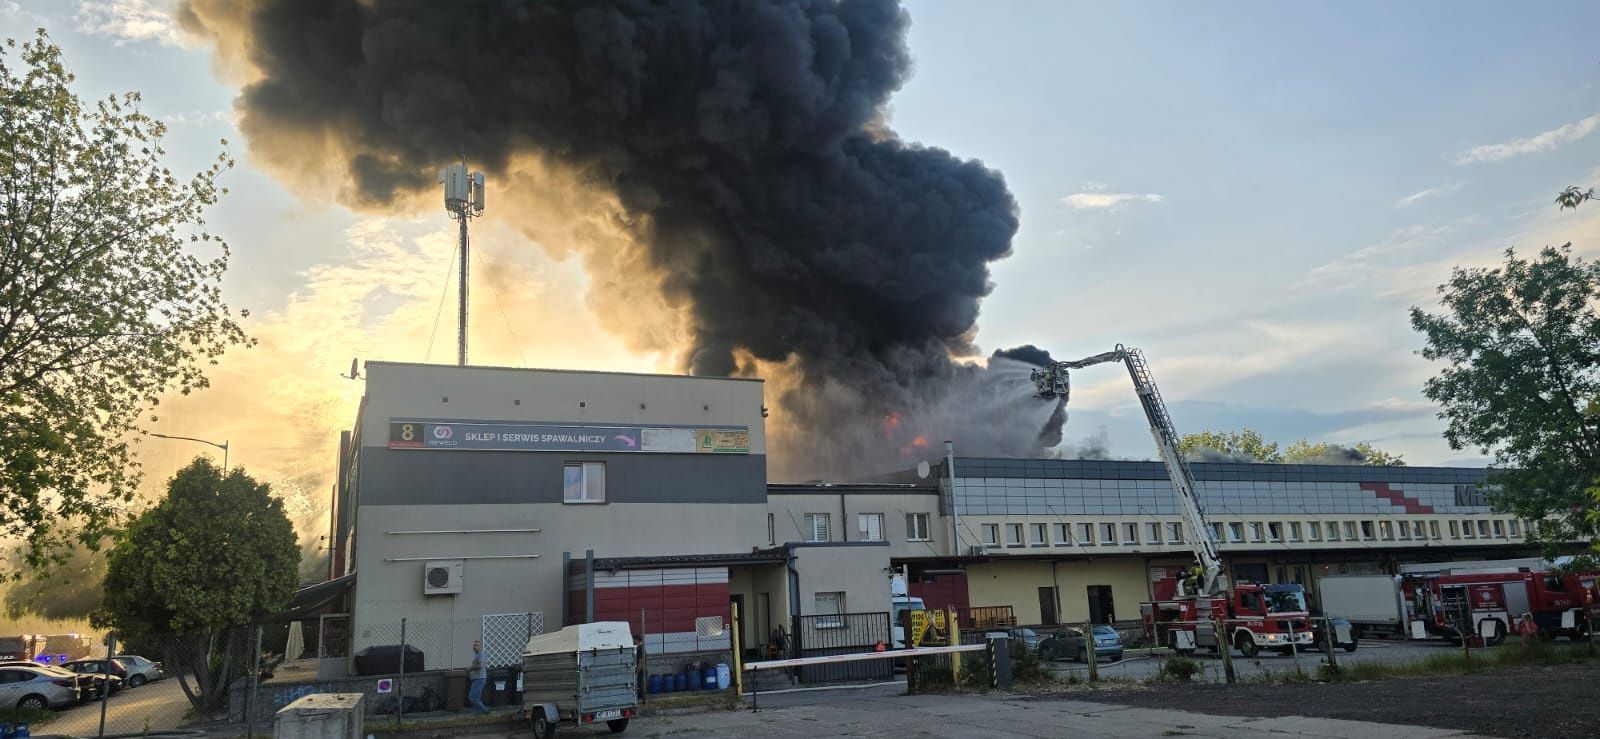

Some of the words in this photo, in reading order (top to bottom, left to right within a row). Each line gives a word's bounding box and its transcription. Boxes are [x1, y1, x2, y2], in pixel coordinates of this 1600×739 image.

[402, 424, 413, 440] 8
[465, 432, 496, 441] SKLEP
[502, 434, 539, 442] SERWIS
[541, 434, 606, 444] SPAWALNICZY
